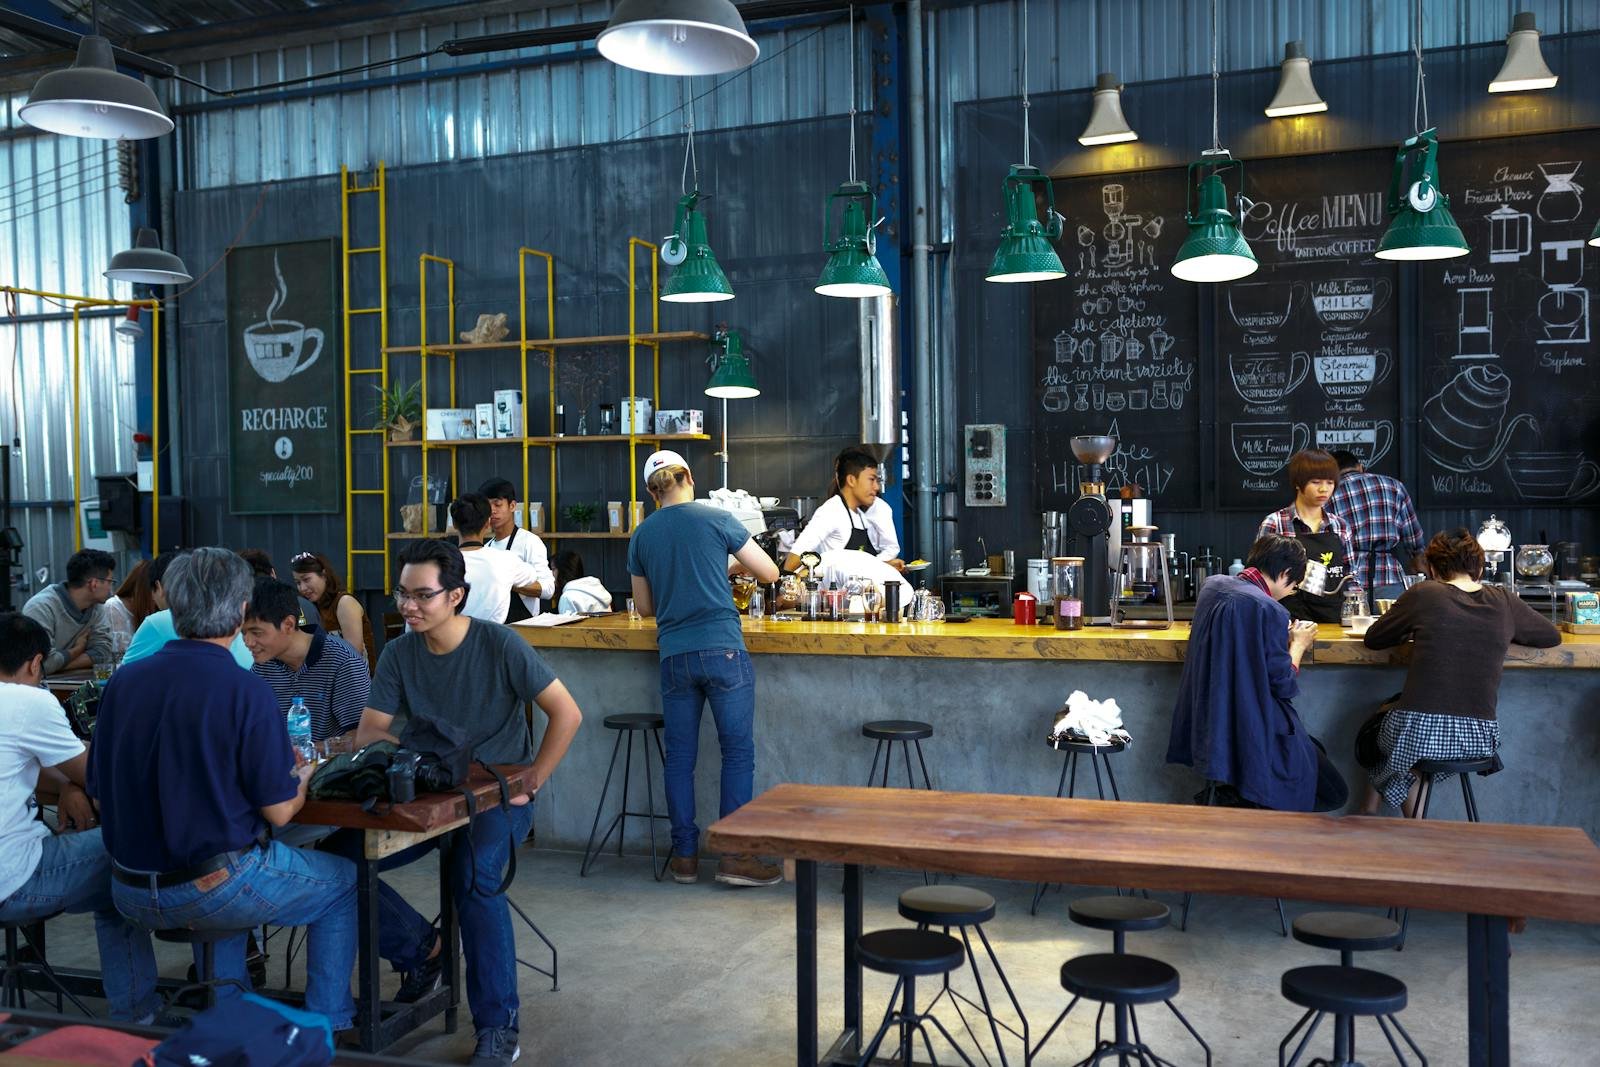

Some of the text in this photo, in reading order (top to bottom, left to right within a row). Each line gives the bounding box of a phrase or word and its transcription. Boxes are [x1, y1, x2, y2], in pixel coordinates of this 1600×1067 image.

[1465, 186, 1534, 204] French Press
[1241, 191, 1382, 252] Coffee MENU
[1333, 239, 1376, 256] COFFEE
[1074, 282, 1098, 296] the
[1317, 281, 1342, 295] Milk
[1322, 296, 1365, 309] MILK
[1072, 318, 1097, 334] the
[1321, 344, 1346, 356] Milk
[1319, 358, 1370, 371] Steamed
[1540, 350, 1587, 374] Syphon
[1042, 365, 1073, 387] the
[1072, 362, 1137, 382] instant
[1323, 369, 1364, 381] MILK
[241, 406, 328, 431] RECHARGE
[1324, 432, 1363, 442] MILK
[1241, 439, 1264, 454] Milk
